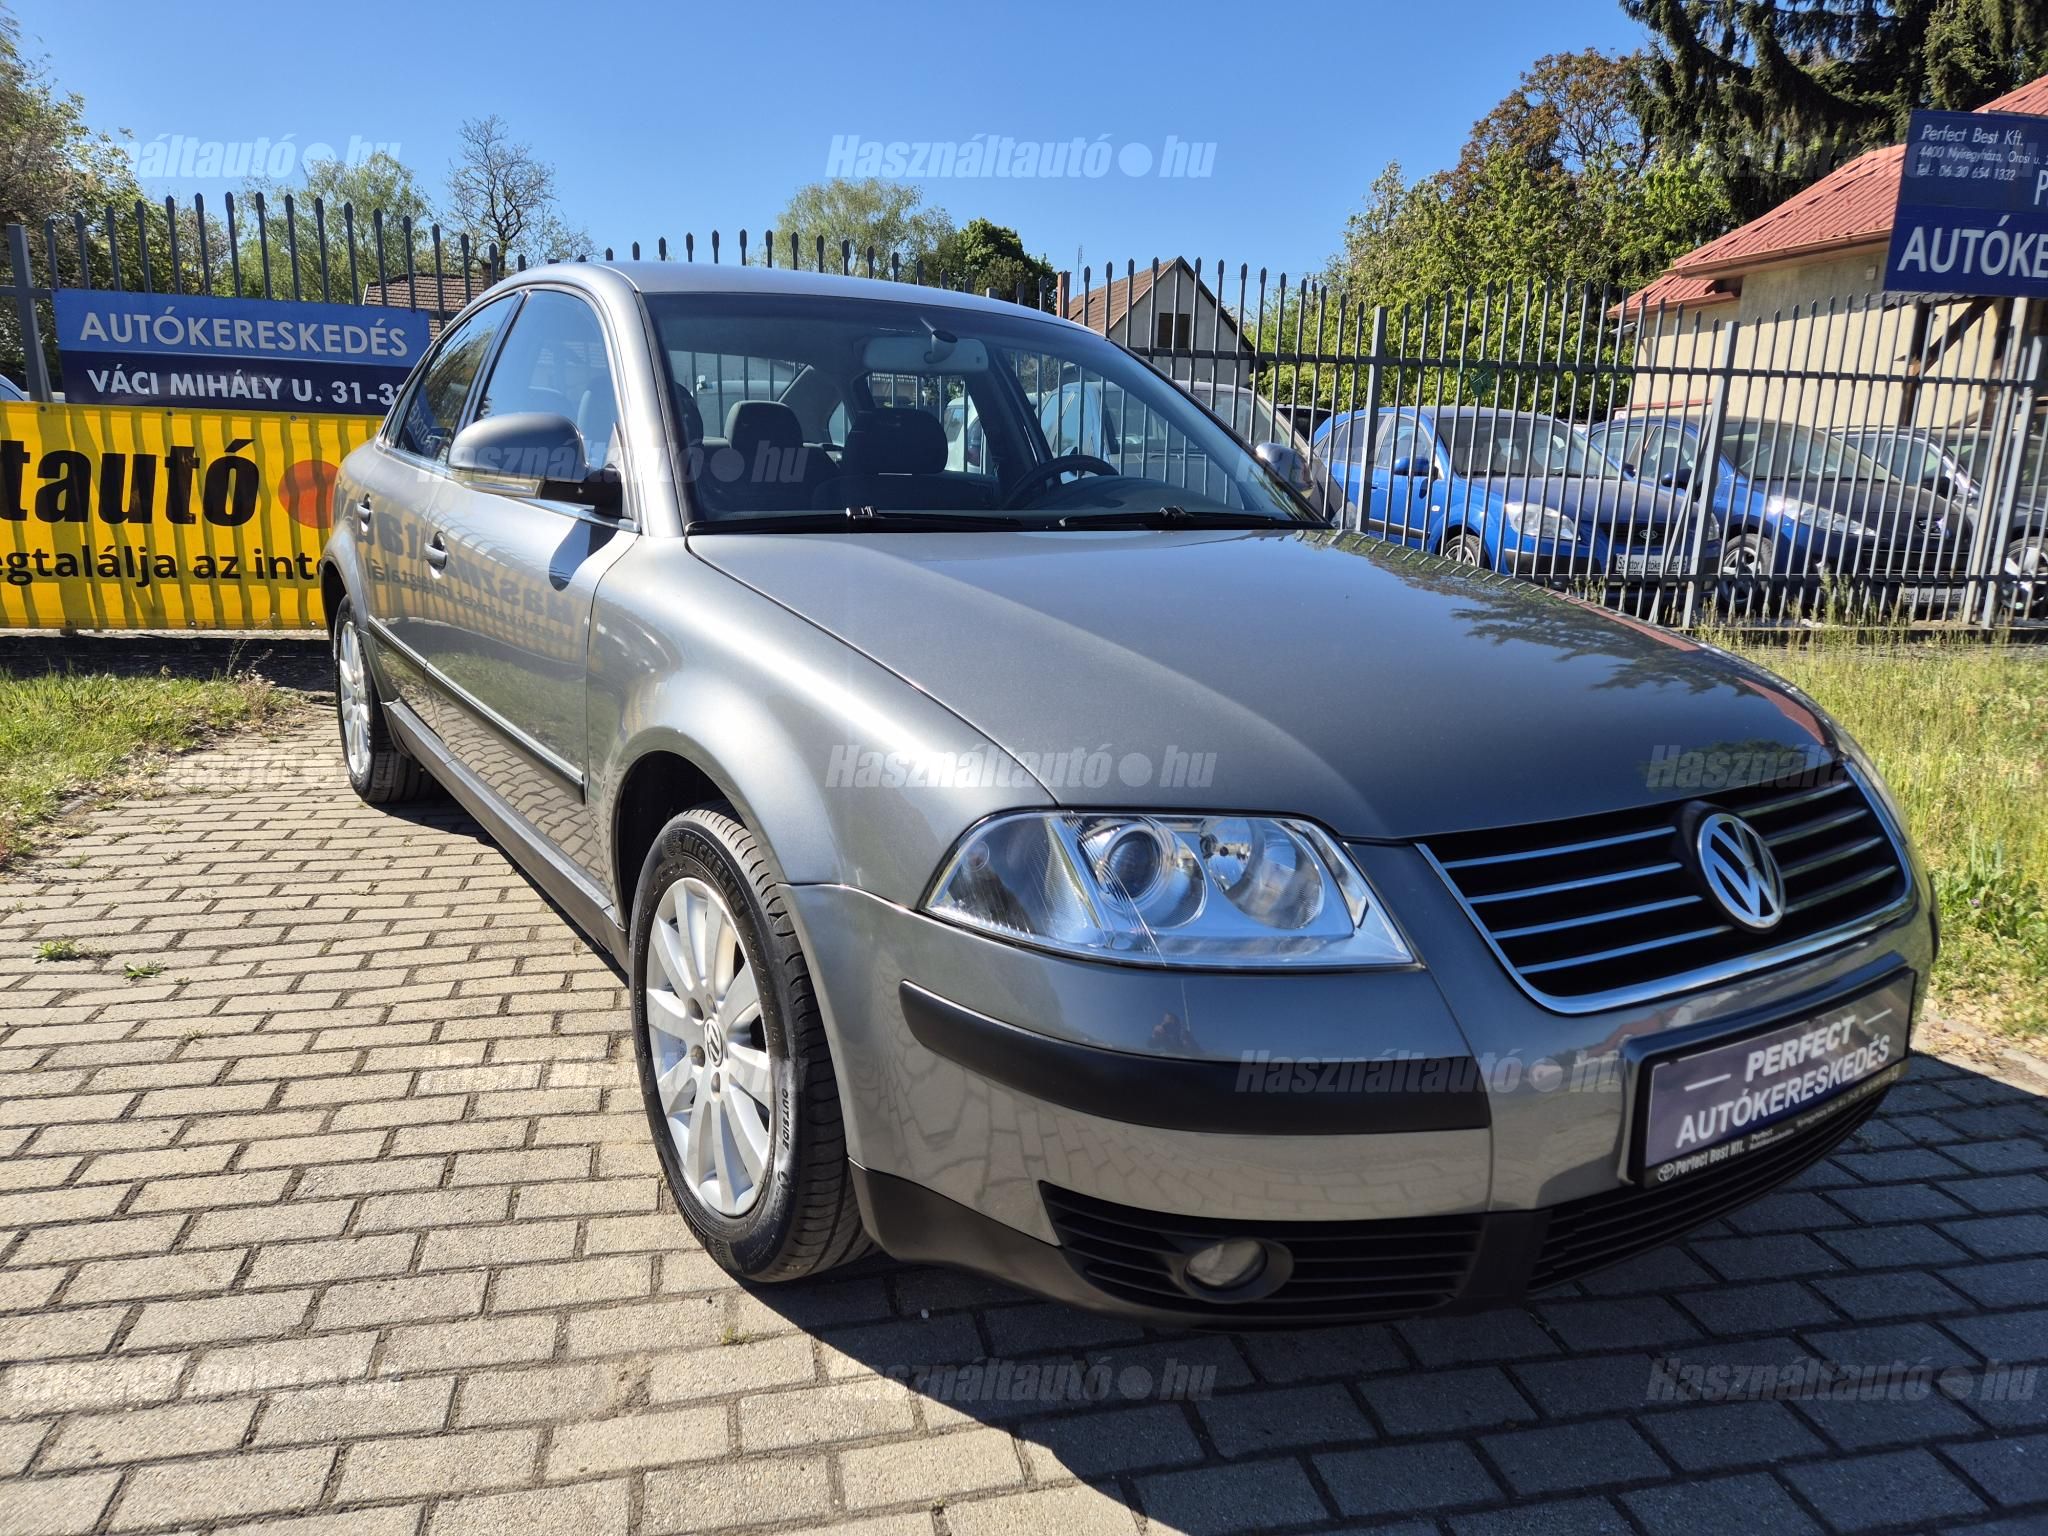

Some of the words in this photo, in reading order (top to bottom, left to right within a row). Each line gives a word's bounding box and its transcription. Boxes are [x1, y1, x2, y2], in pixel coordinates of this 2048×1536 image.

[1921, 124, 1967, 142] Perfect
[1972, 127, 1999, 144] Best
[2004, 129, 2024, 146] Kft.
[80, 305, 408, 358] AUTÓKERESKEDÉS
[86, 363, 159, 396] VÁCI
[170, 370, 283, 401] MIHÁLY
[292, 386, 323, 403] U.
[331, 380, 404, 407] 31-3
[0, 546, 178, 587] gtalálja
[193, 551, 242, 580] az
[1745, 1014, 1856, 1083] PERFECT
[1675, 1032, 1892, 1149] AUTÓKERESKEDÉS
[780, 1087, 791, 1151] OUTSIDE
